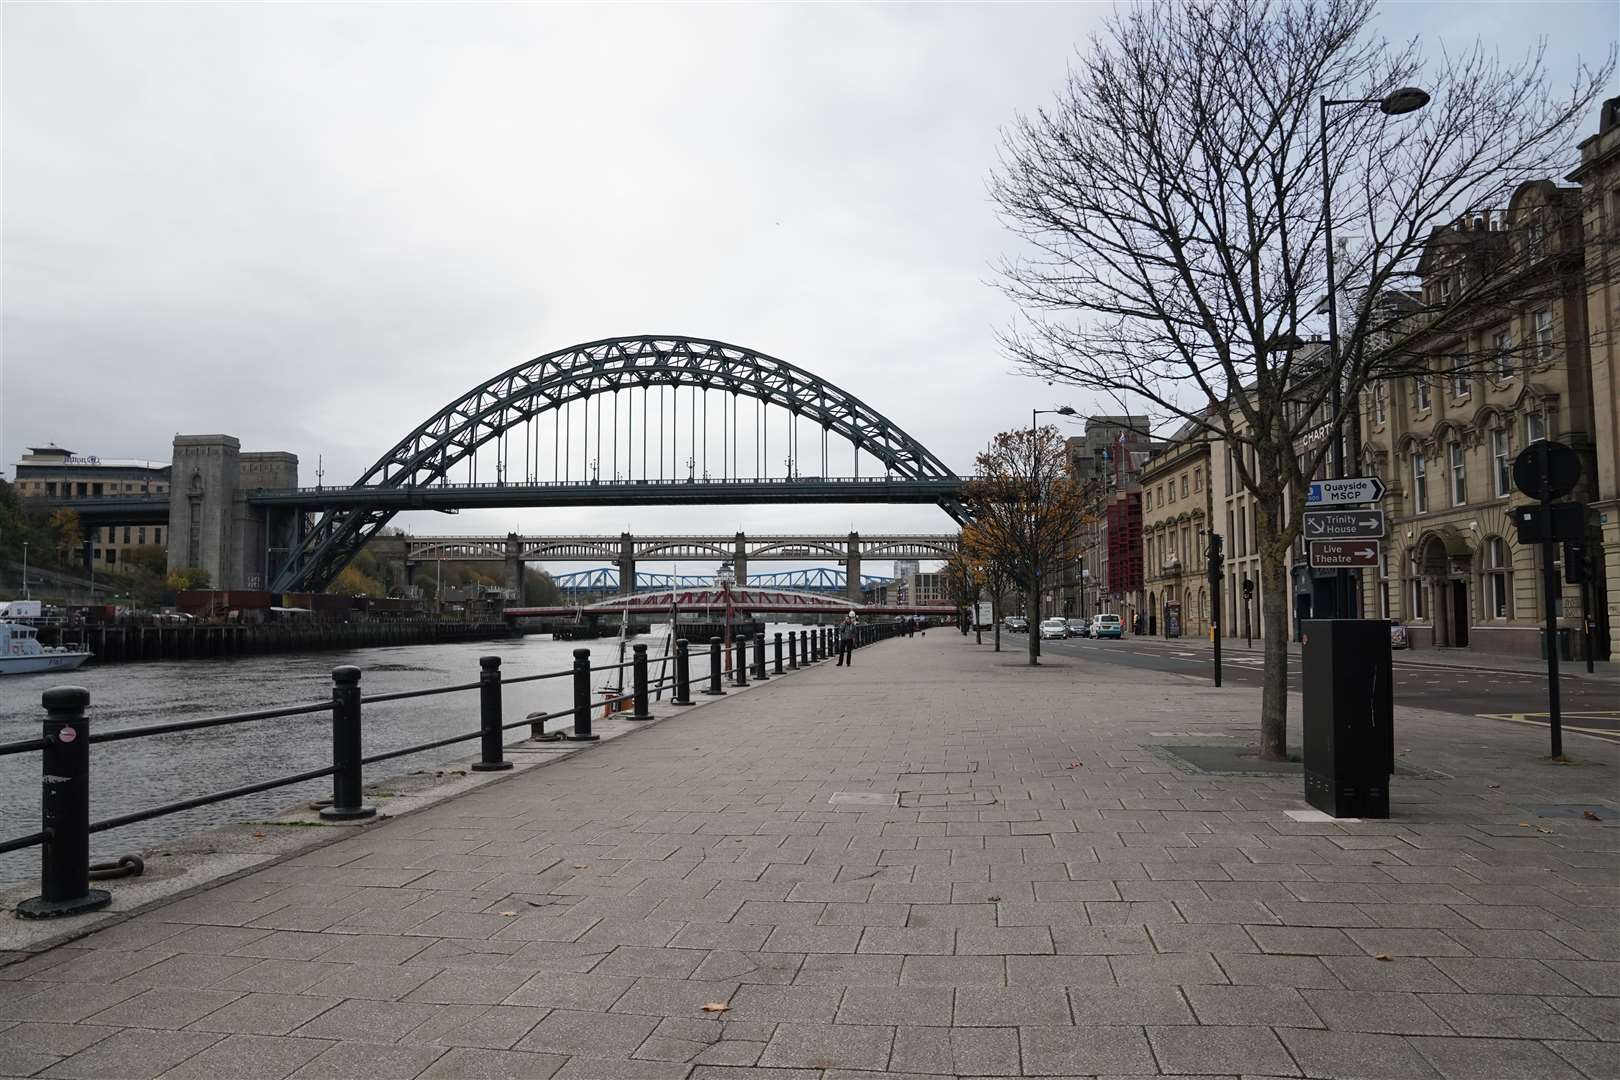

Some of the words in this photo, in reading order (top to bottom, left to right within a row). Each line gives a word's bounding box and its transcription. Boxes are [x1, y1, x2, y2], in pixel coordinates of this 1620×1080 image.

[1324, 482, 1367, 492] Quayside
[1331, 491, 1361, 500] MSCP
[1326, 513, 1356, 524] Trinity
[1327, 525, 1357, 534] House
[1323, 545, 1342, 553] Live
[1315, 554, 1352, 563] Theatre
